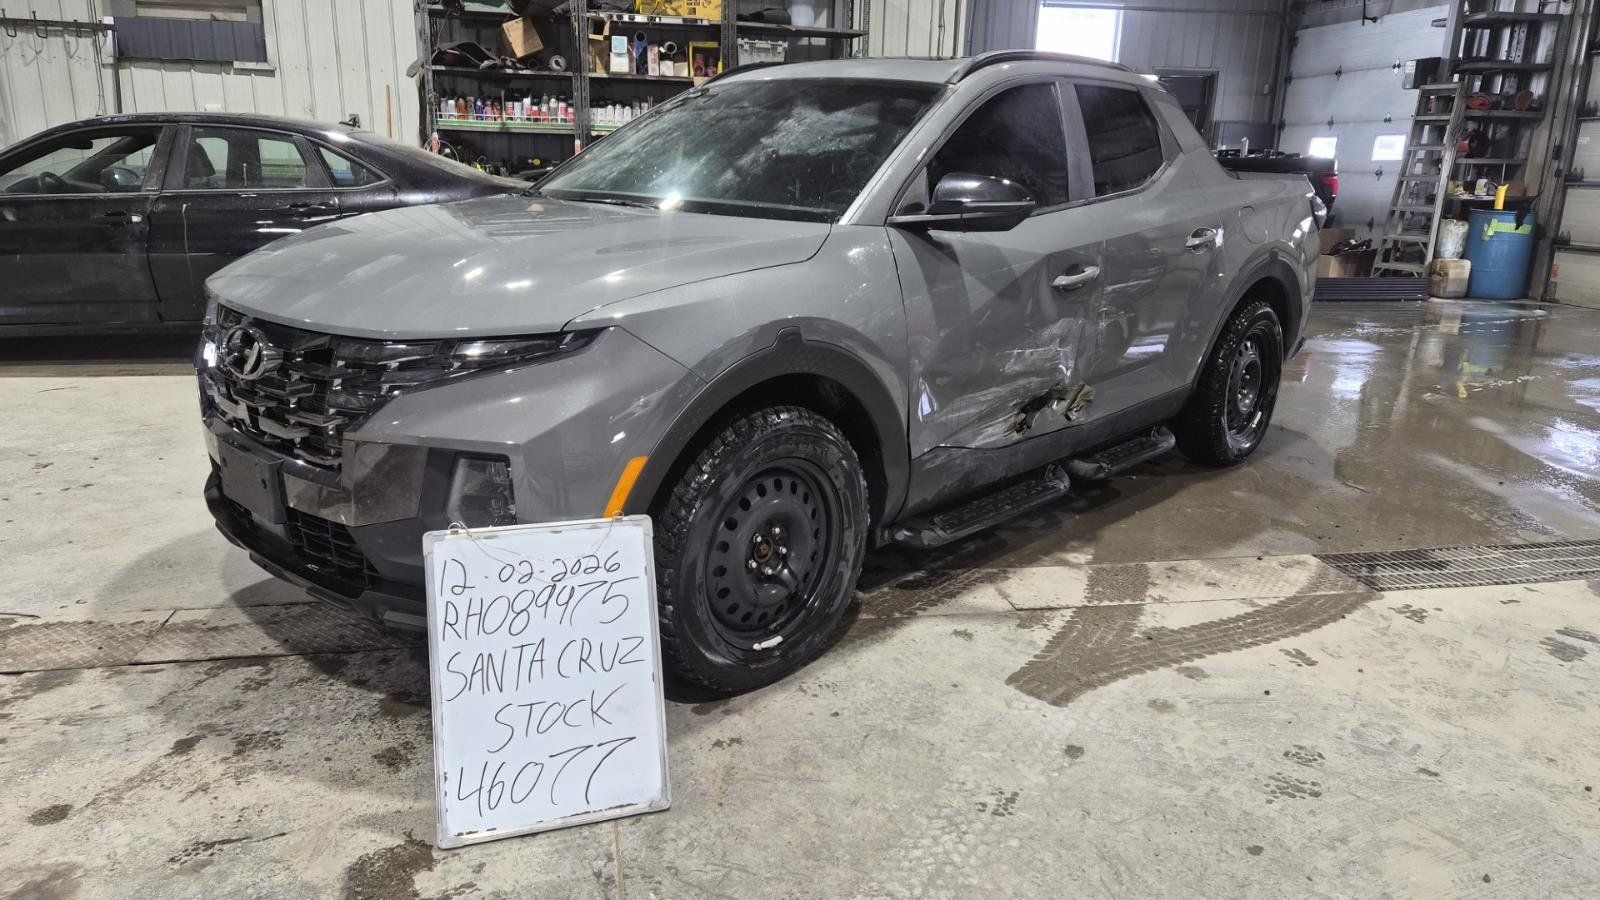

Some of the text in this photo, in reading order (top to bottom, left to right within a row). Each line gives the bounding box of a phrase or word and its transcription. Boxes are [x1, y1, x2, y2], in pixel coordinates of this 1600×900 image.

[446, 636, 646, 702] SANTA CRUZ
[487, 683, 629, 753] STOCK
[457, 736, 637, 817] 46077
